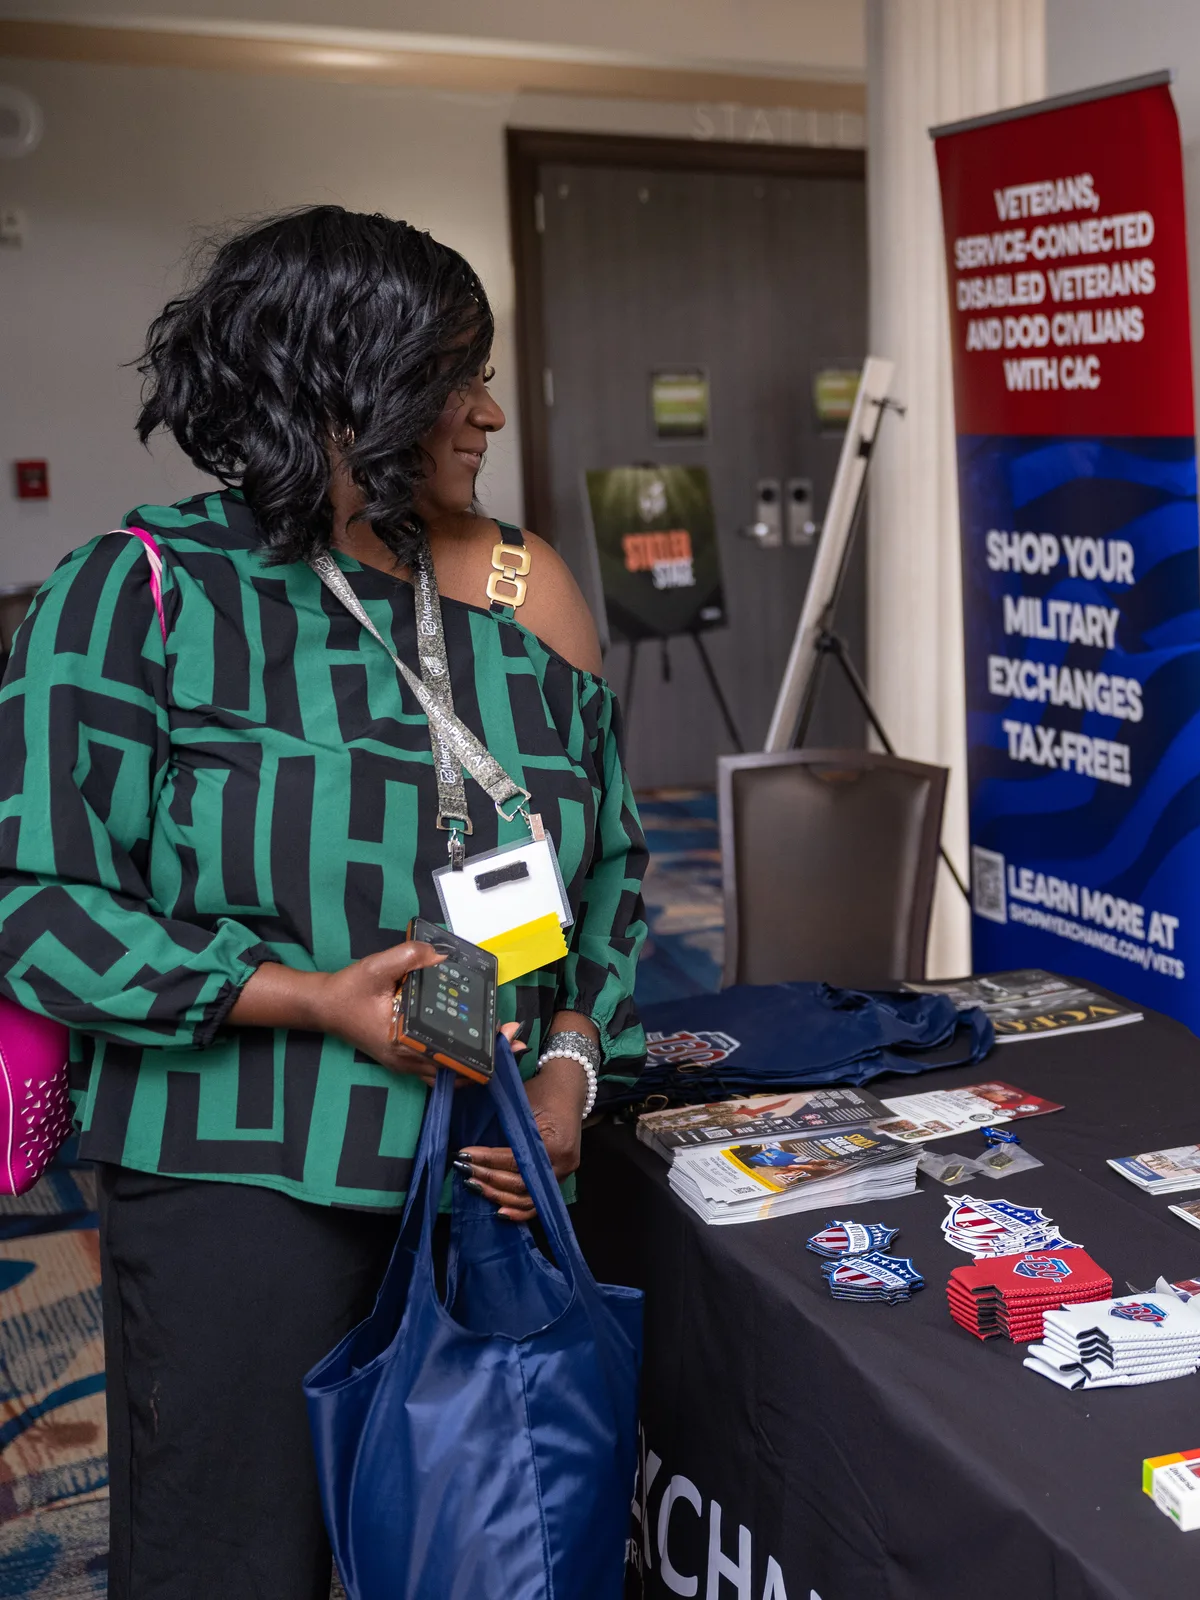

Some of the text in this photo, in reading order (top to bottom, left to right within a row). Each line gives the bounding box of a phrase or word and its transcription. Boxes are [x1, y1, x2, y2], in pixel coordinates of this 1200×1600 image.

[994, 173, 1099, 221] VETERANS,
[954, 211, 1155, 270] SERVICE-CONNECTED
[956, 258, 1156, 311] DISABLED VETERANS
[966, 306, 1144, 351] AND DOD CIVILIANS
[1003, 355, 1101, 391] WITH CAC
[986, 530, 1135, 585] SHOP YOUR
[1003, 594, 1120, 651] MILITARY
[988, 655, 1144, 723] EXCHANGES
[1002, 720, 1132, 787] TAX-FREE!
[1007, 864, 1180, 950] LEARN MORE AT
